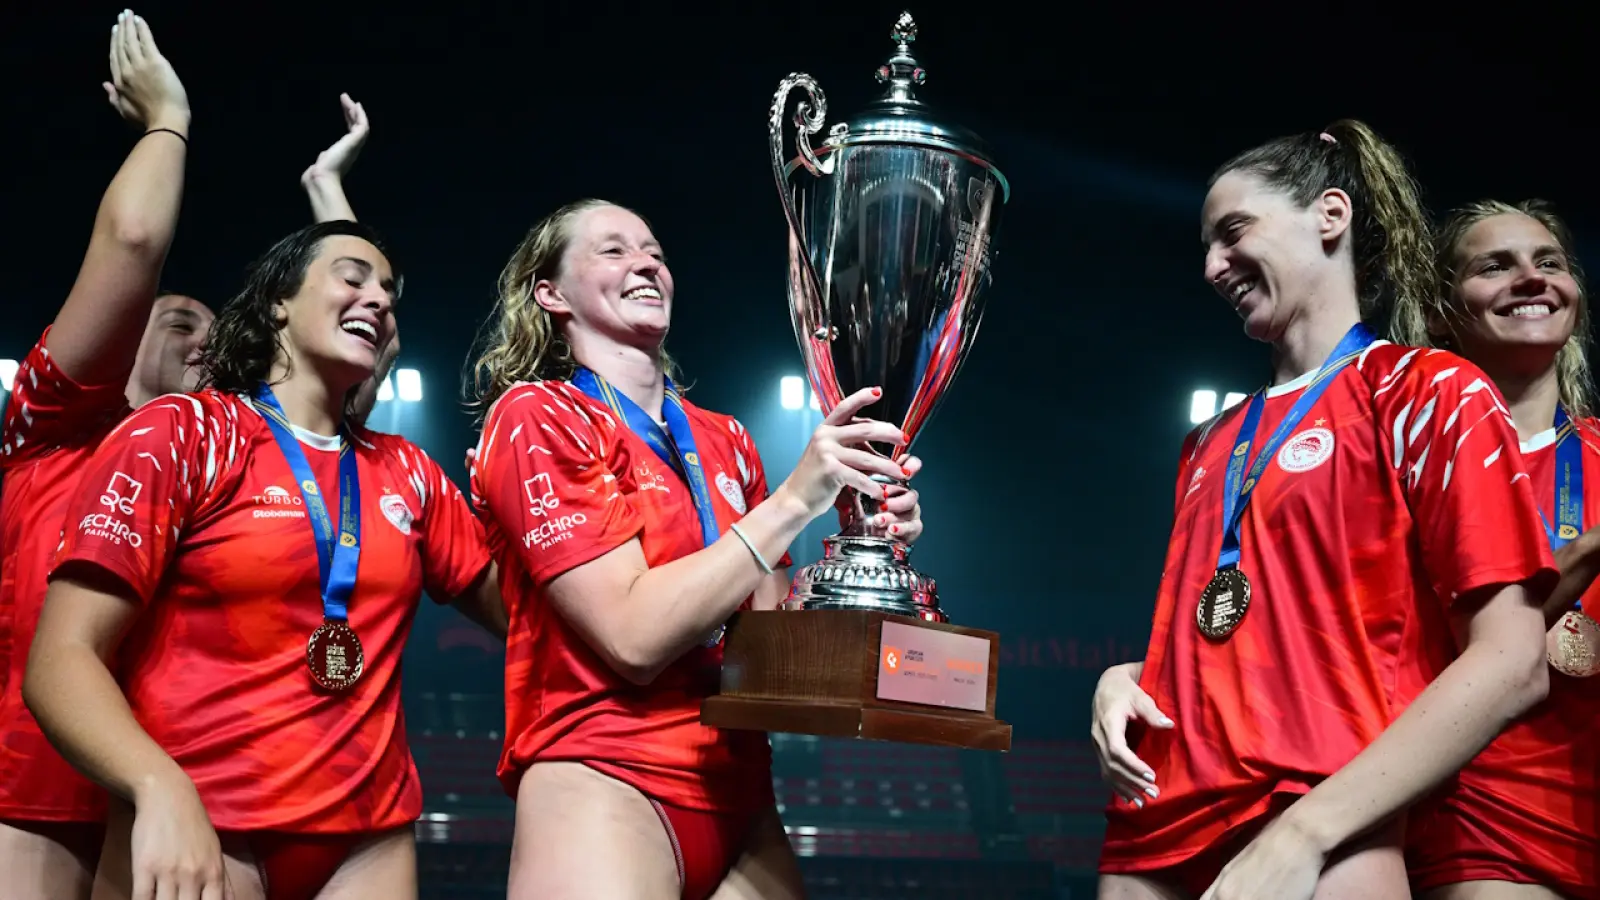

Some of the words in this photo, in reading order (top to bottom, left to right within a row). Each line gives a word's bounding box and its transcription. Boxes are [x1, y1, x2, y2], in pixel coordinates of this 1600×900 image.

[251, 495, 302, 506] TURBO
[84, 528, 121, 545] PAINTS
[522, 511, 588, 550] VECHRO
[541, 530, 574, 551] PAINTS
